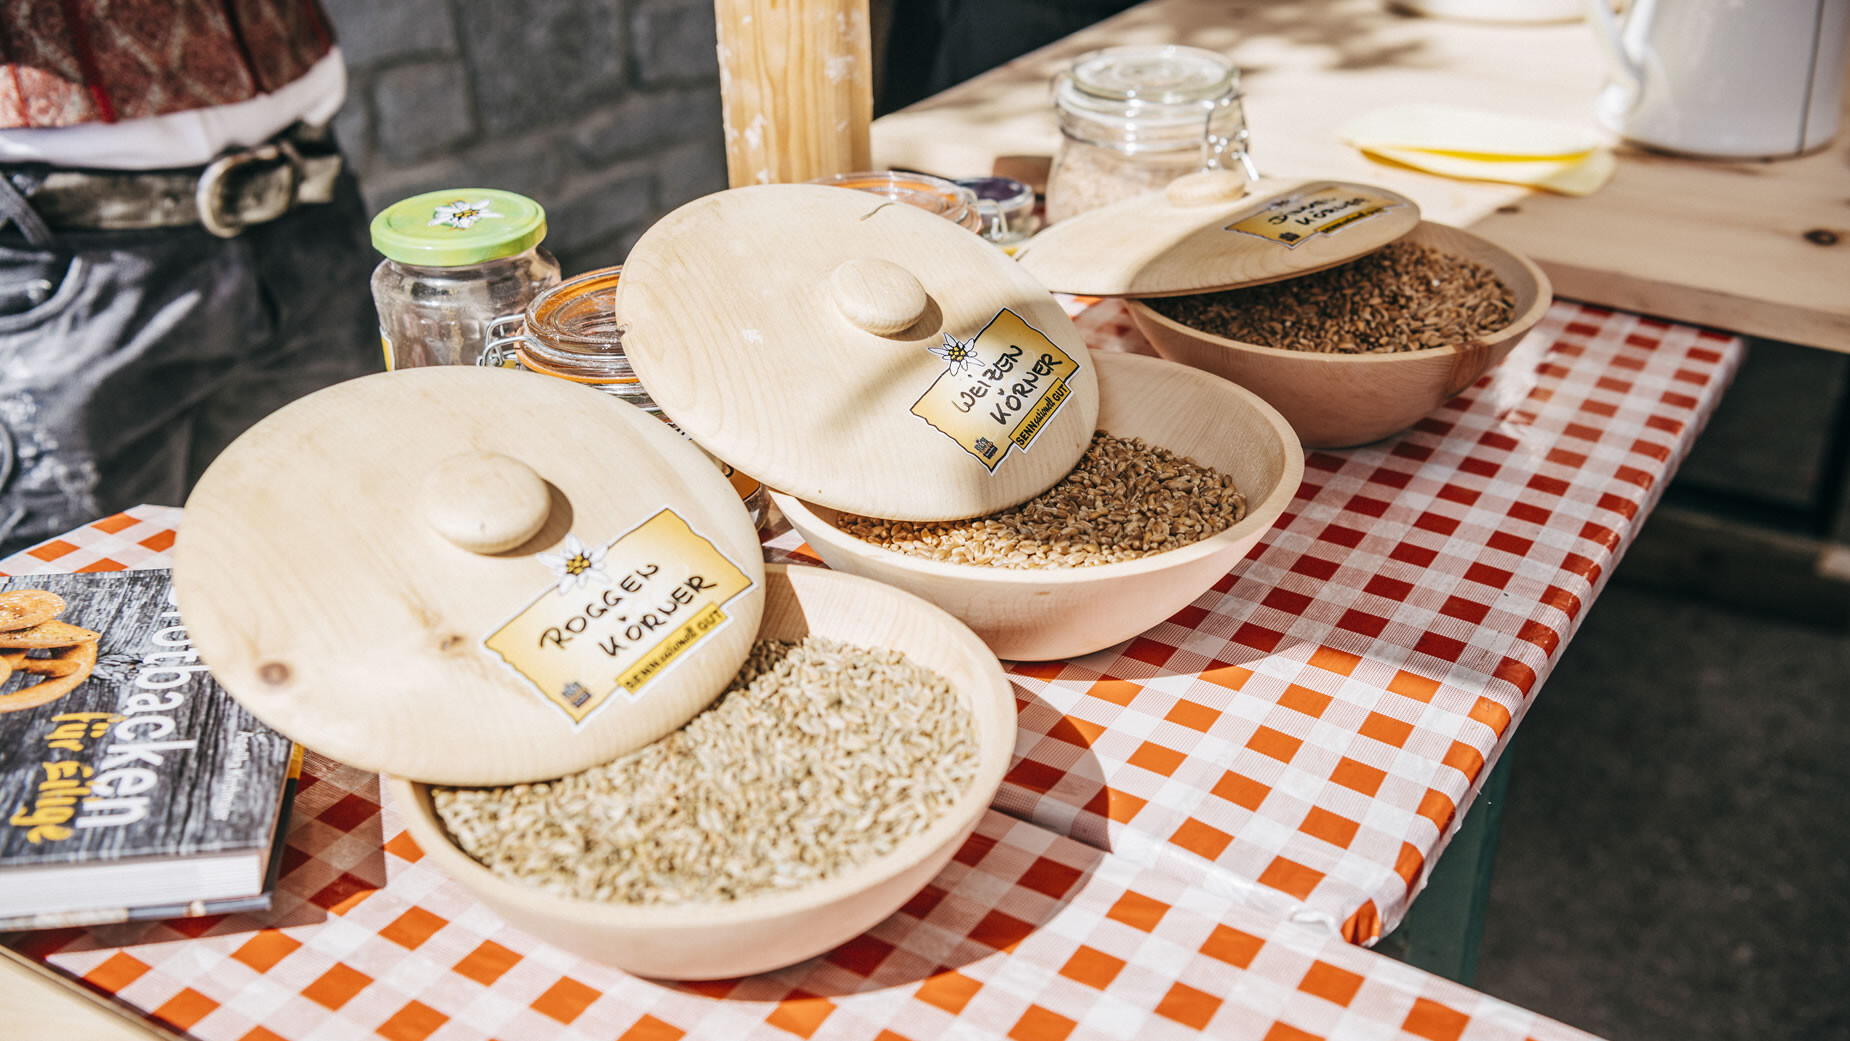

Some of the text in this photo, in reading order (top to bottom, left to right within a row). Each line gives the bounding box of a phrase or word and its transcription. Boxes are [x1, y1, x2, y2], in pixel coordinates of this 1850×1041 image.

[952, 345, 1024, 413] WEIZEN
[990, 353, 1062, 425] KÖRNER
[1052, 383, 1068, 402] GUT
[540, 564, 659, 649] ROGGEN
[599, 575, 718, 657] KÖRNER
[697, 609, 722, 632] GUT
[75, 586, 211, 829] otbacken
[10, 711, 127, 844] für Eilige
